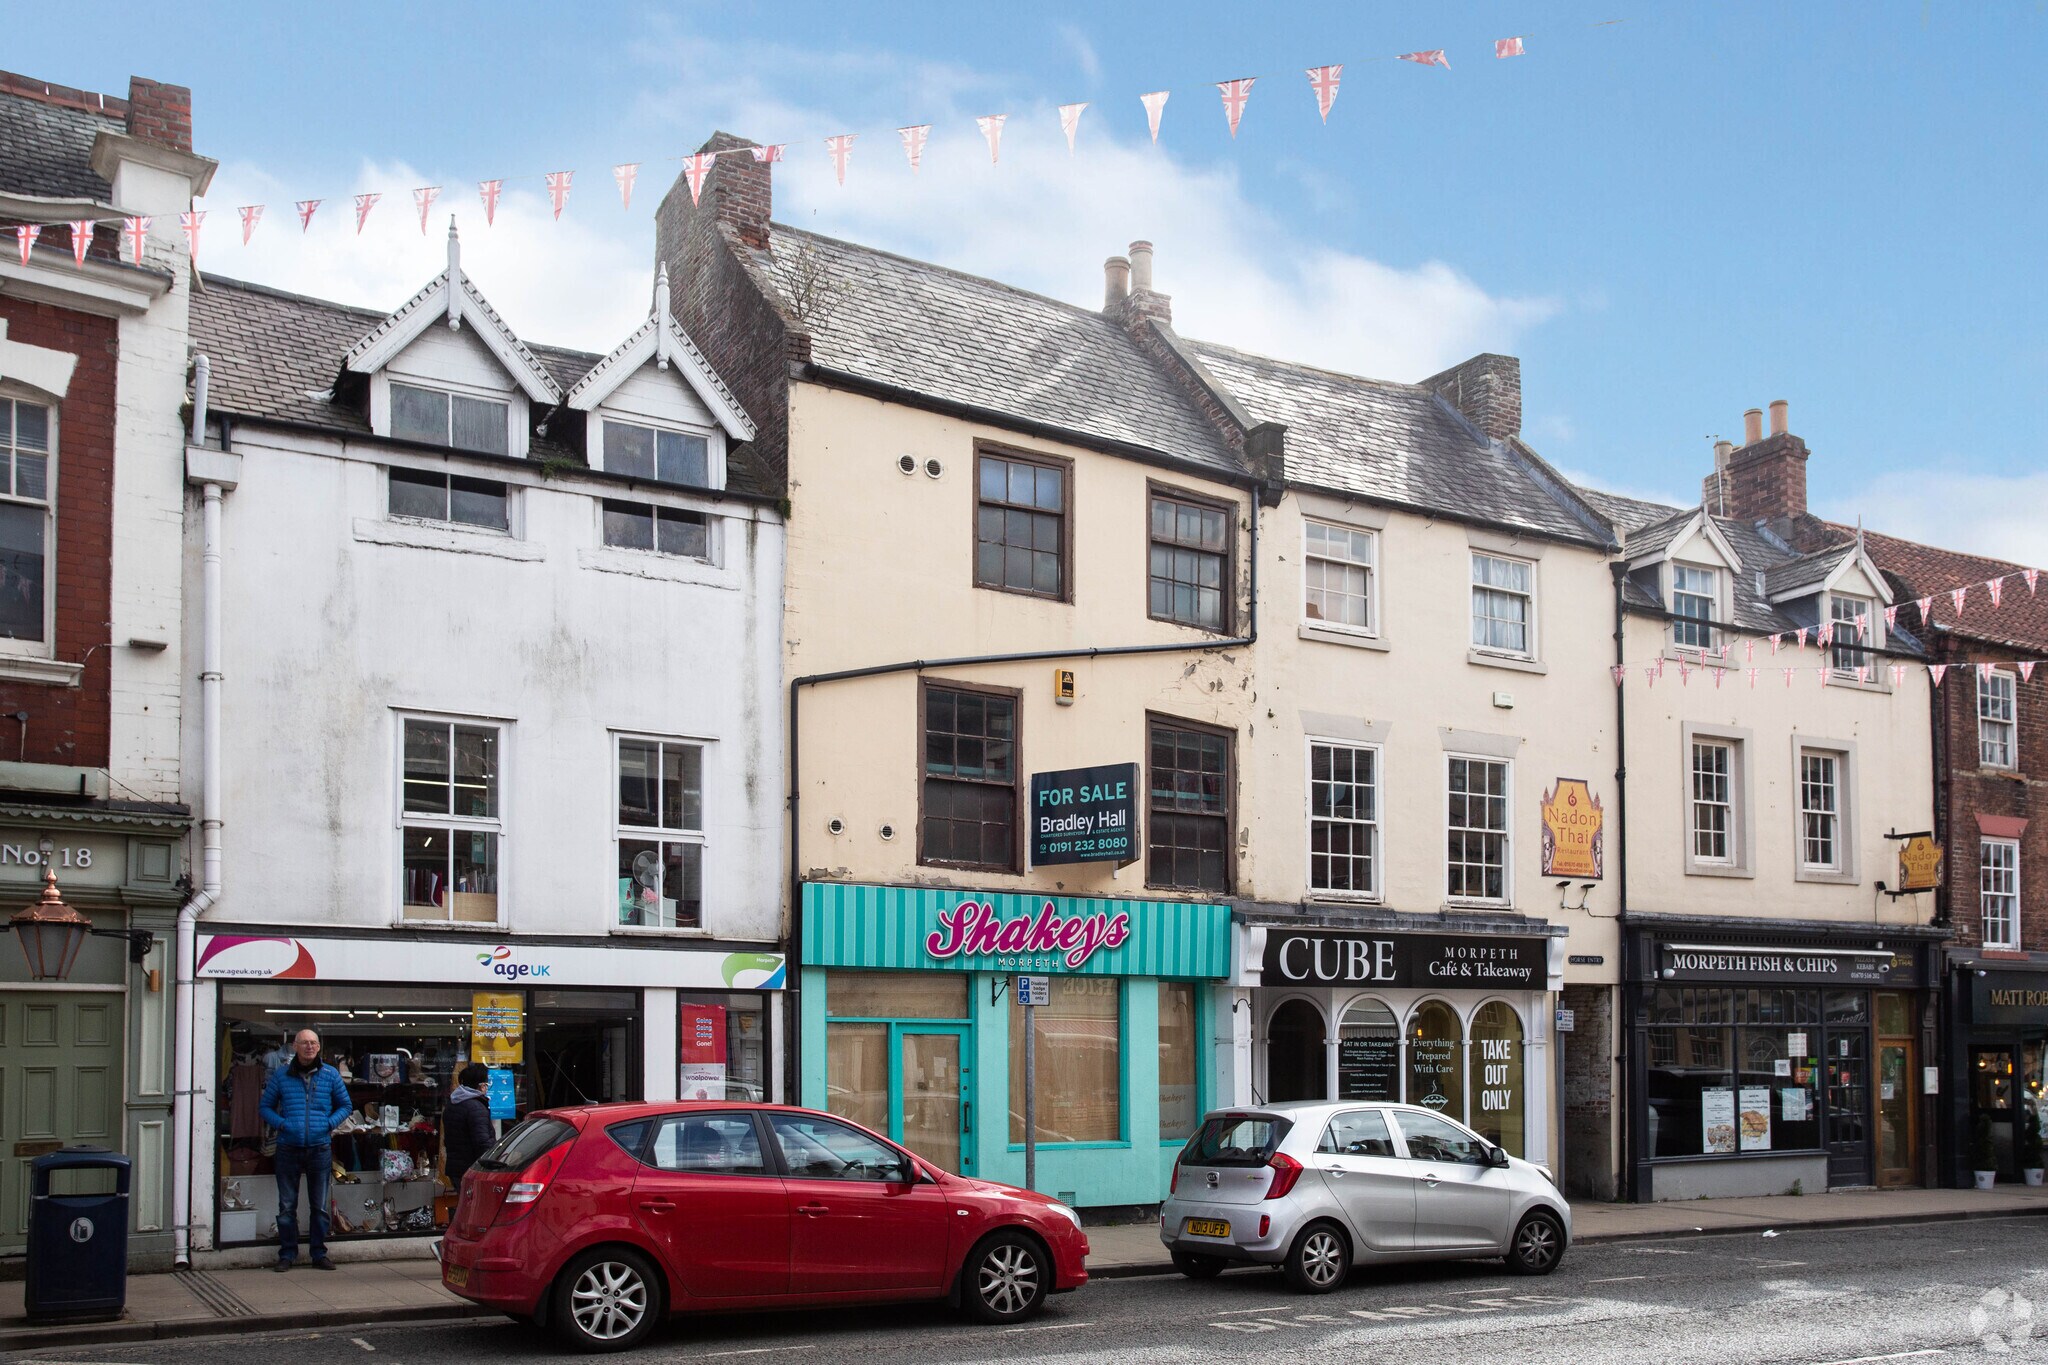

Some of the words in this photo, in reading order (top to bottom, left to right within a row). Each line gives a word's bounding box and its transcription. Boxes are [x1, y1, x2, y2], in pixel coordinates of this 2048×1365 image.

[1040, 788, 1074, 807] FOR
[1080, 782, 1126, 803] SALE
[1040, 813, 1094, 835] Bradley
[1098, 809, 1126, 828] Hall
[1548, 808, 1597, 826] Nadon
[1558, 827, 1588, 844] Thai
[1049, 842, 1072, 853] 0191
[1074, 840, 1095, 851] 232
[1098, 837, 1128, 849] 8080
[1557, 847, 1589, 856] Restaurant
[1, 844, 48, 866] No.
[61, 847, 92, 868] 18
[1904, 852, 1938, 862] Nadon
[926, 900, 1129, 968] Shakeys
[1280, 937, 1396, 980] CUBE
[1445, 946, 1518, 960] MORPETH
[998, 957, 1059, 968] MORPETH
[1673, 954, 1746, 970] MORPETH
[1749, 956, 1780, 972] FISH
[1783, 957, 1794, 972] &
[1797, 957, 1837, 973] CHIPS
[494, 963, 528, 980] age
[530, 965, 550, 976] UK
[1429, 961, 1457, 976] Café
[1460, 963, 1472, 976] &
[1474, 962, 1532, 982] Takeaway
[1991, 989, 2024, 1006] MATT
[475, 1030, 504, 1038] Springing
[1412, 1038, 1454, 1049] Everything
[1481, 1040, 1511, 1059] TAKE
[1416, 1051, 1450, 1062] Prepared
[1414, 1064, 1434, 1073] With
[1436, 1064, 1453, 1073] Care
[1485, 1064, 1508, 1085] OUT
[1482, 1090, 1511, 1110] ONLY
[1192, 1222, 1208, 1233] ND13
[1210, 1223, 1225, 1234] UFB
